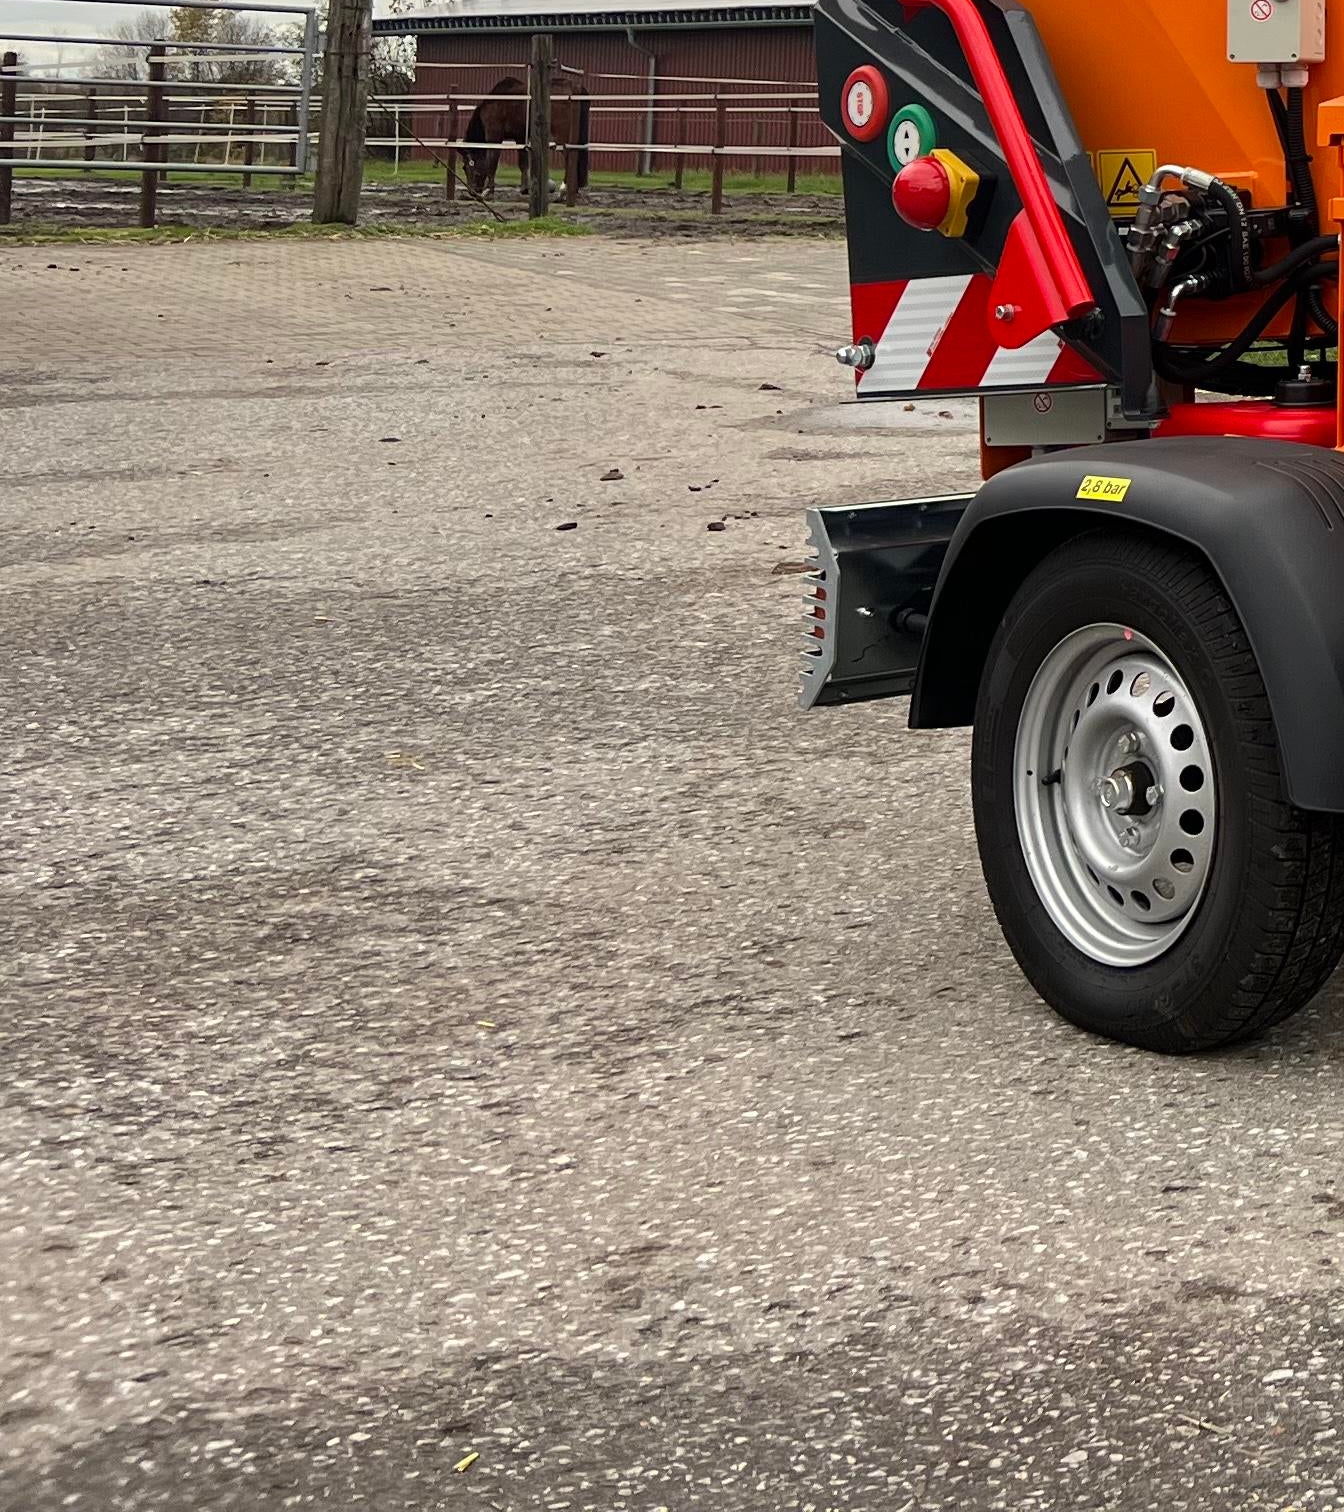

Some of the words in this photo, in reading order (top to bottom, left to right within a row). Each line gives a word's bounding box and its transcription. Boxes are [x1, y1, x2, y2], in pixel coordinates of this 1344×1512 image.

[856, 91, 864, 117] STOP
[1081, 479, 1103, 495] 2,8
[1103, 481, 1127, 494] bar
